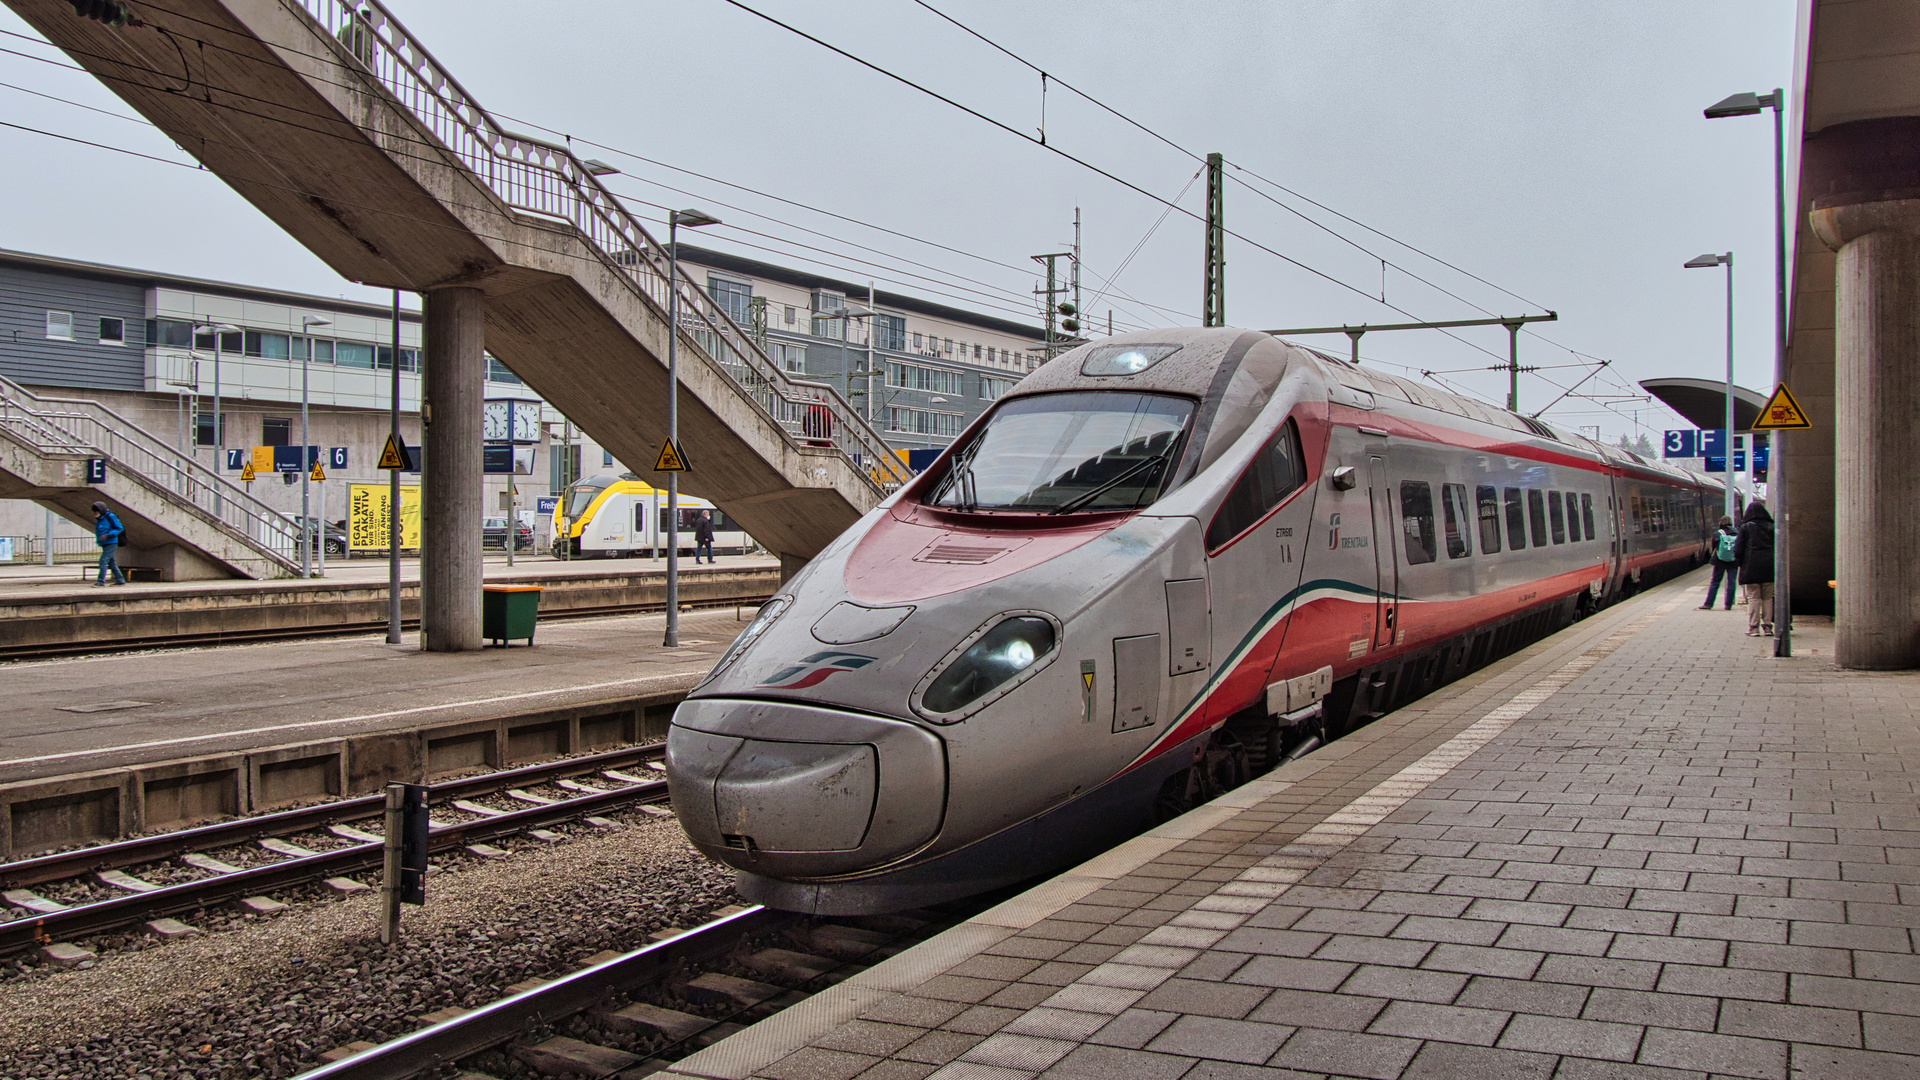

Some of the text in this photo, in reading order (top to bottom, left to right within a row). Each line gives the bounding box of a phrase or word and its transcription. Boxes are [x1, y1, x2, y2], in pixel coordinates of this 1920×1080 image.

[1667, 430, 1716, 452] 3 F
[228, 450, 237, 466] 7
[335, 448, 344, 465] 6
[93, 459, 102, 478] E
[353, 495, 361, 516] WIE
[540, 501, 556, 509] Freib
[361, 490, 369, 546] PLAKATIV
[1341, 536, 1369, 549] TRENITALIA
